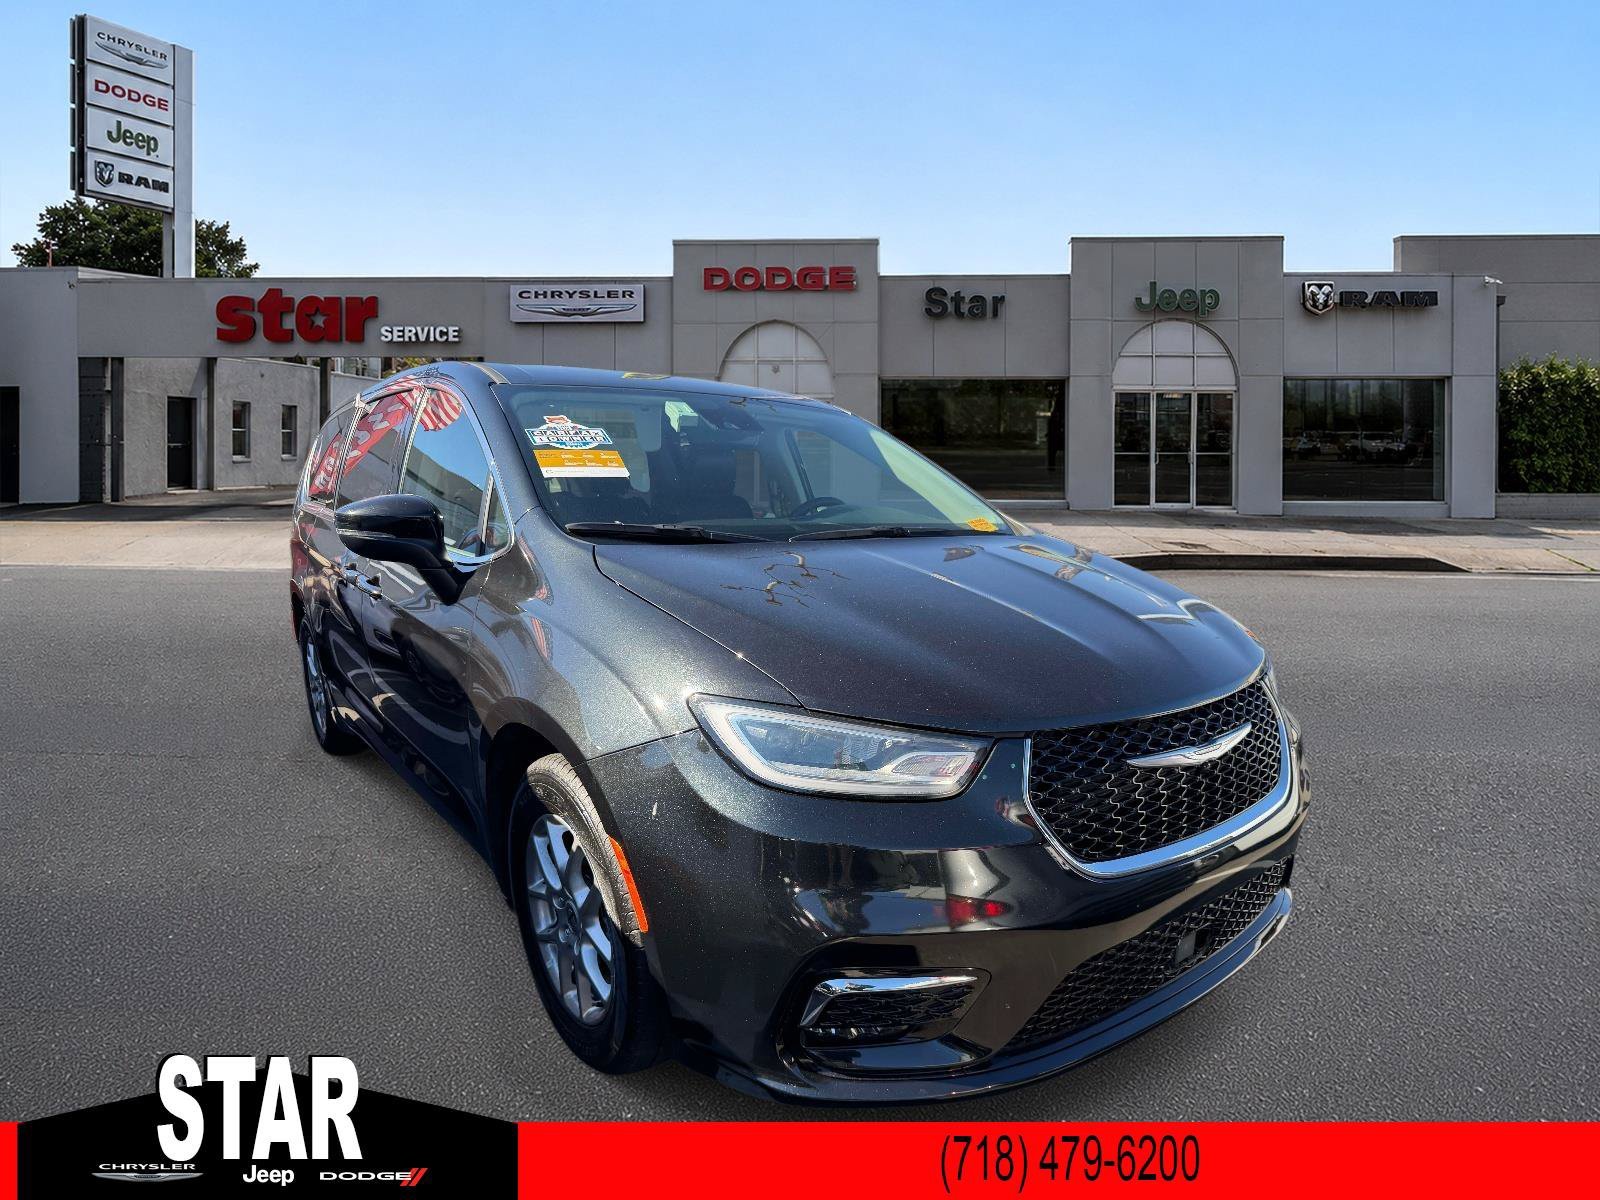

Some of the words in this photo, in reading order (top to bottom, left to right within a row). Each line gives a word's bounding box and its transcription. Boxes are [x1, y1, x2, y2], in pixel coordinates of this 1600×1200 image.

[97, 31, 168, 61] CHRYSLER
[94, 79, 169, 111] DODGE
[107, 120, 159, 156] Jeep
[118, 171, 169, 193] RAM
[703, 266, 857, 291] DODGE
[518, 289, 635, 300] CHRYSLER
[924, 286, 1006, 320] Star
[1135, 281, 1220, 316] Jeep
[1338, 290, 1438, 307] RAM
[215, 288, 379, 343] star
[380, 326, 460, 344] SERVICE
